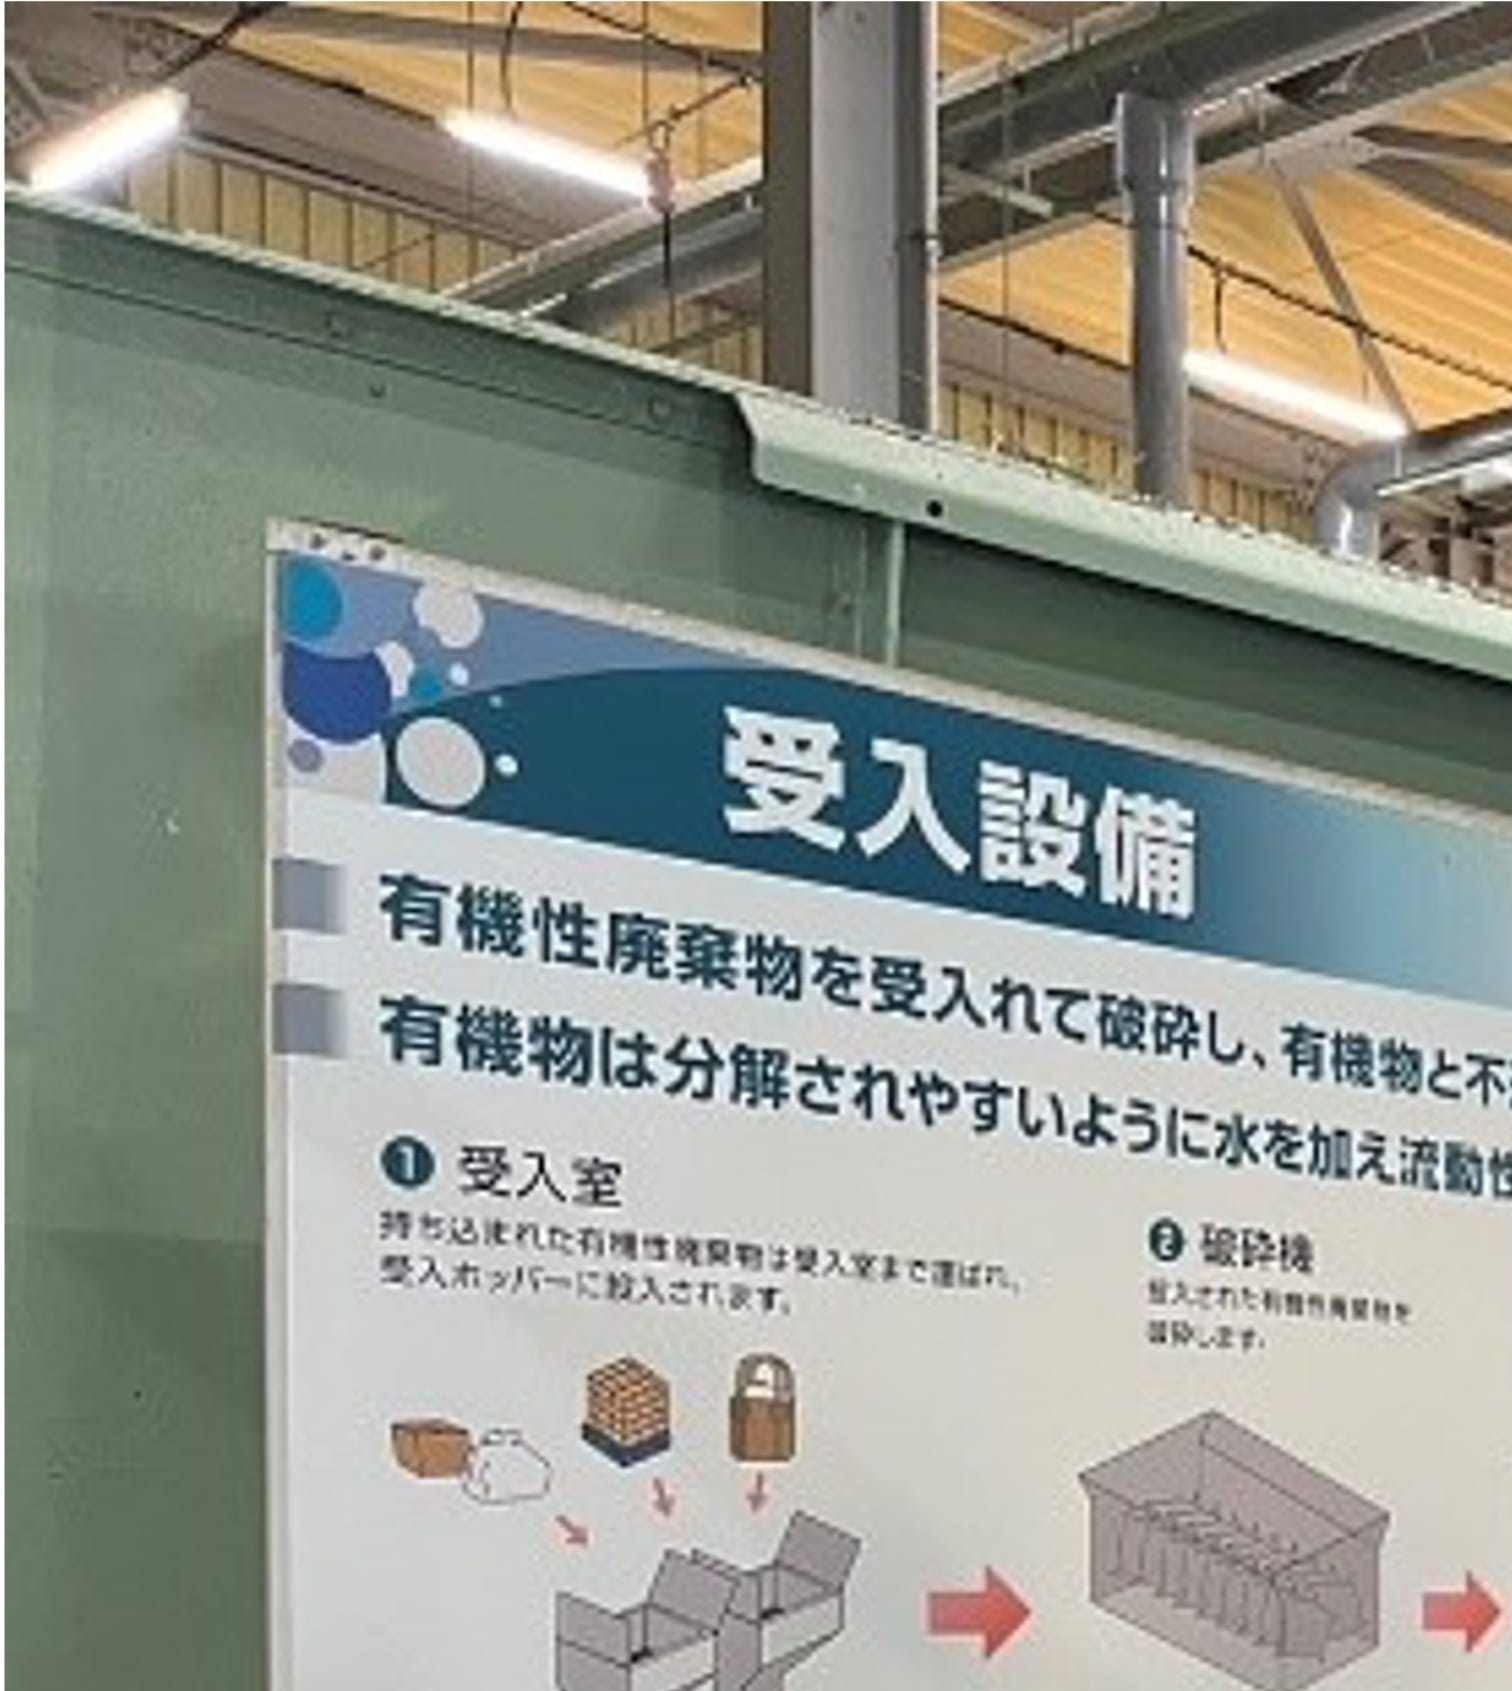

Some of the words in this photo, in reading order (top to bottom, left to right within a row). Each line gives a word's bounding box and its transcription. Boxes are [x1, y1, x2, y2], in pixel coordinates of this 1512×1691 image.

[722, 705, 1196, 920] 受入設備
[459, 1145, 624, 1208] 受入室
[1200, 1223, 1314, 1274] 破砕機
